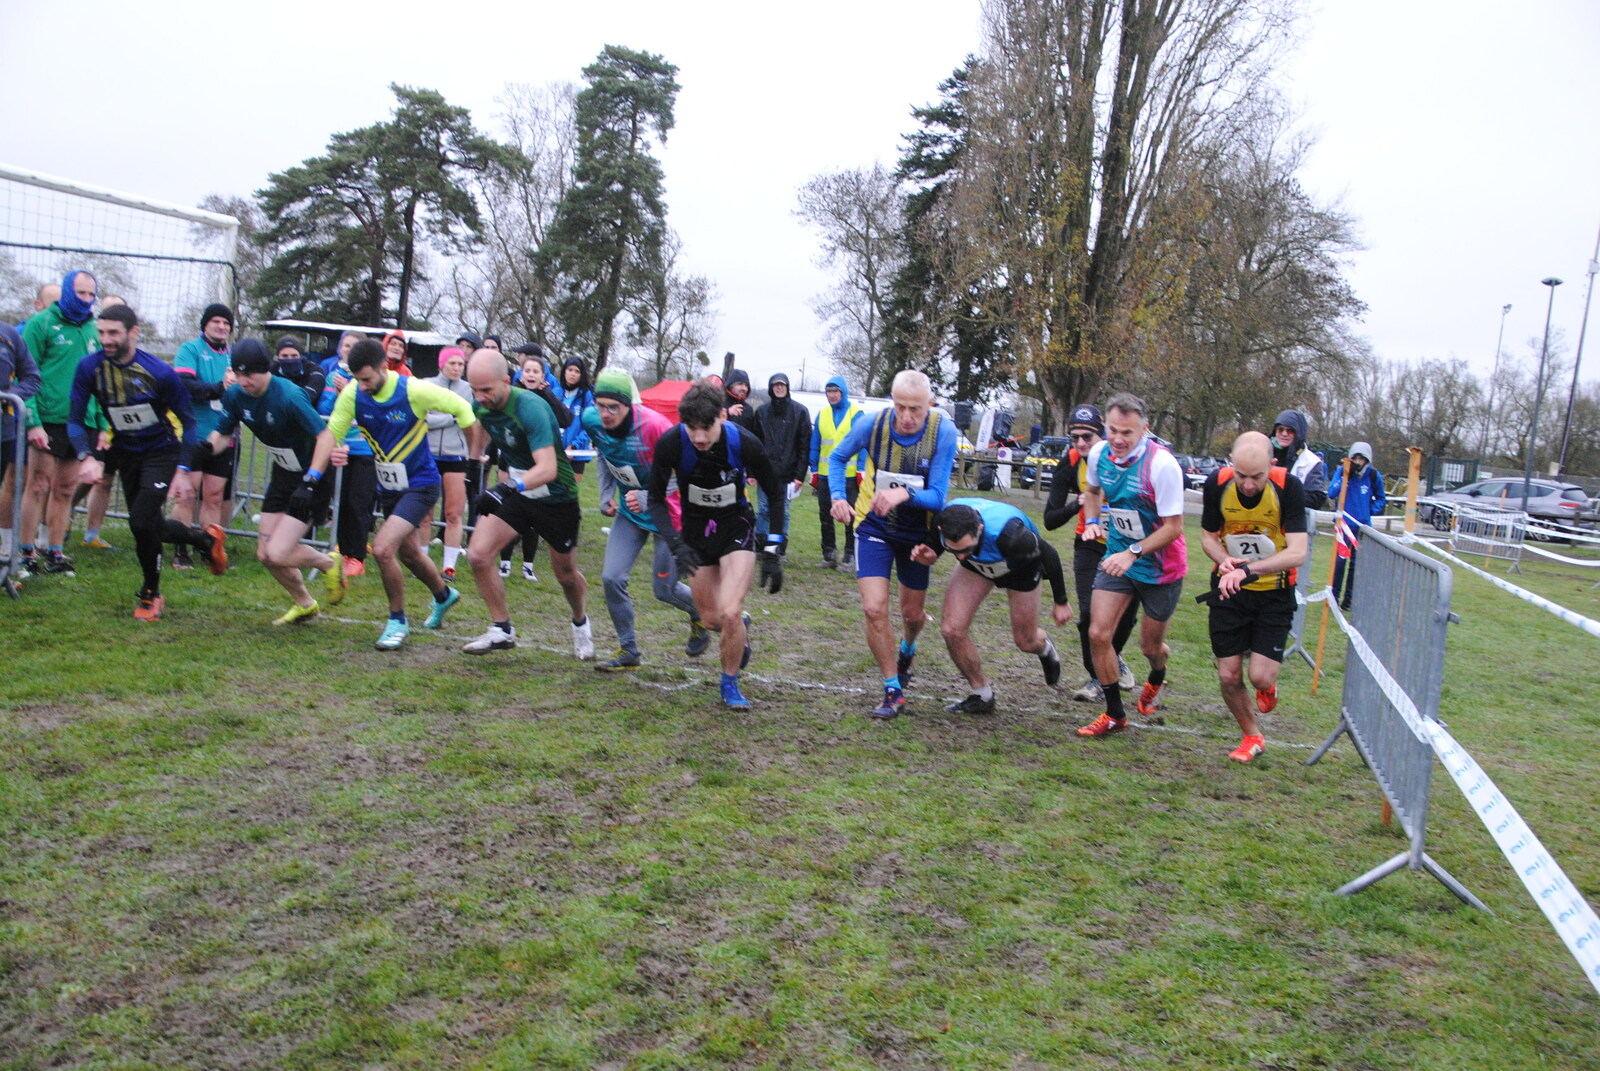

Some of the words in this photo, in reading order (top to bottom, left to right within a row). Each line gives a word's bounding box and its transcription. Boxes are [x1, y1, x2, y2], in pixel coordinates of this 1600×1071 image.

[122, 412, 141, 424] 81
[377, 469, 398, 484] 121
[702, 494, 722, 503] 53
[1240, 542, 1261, 555] 21
